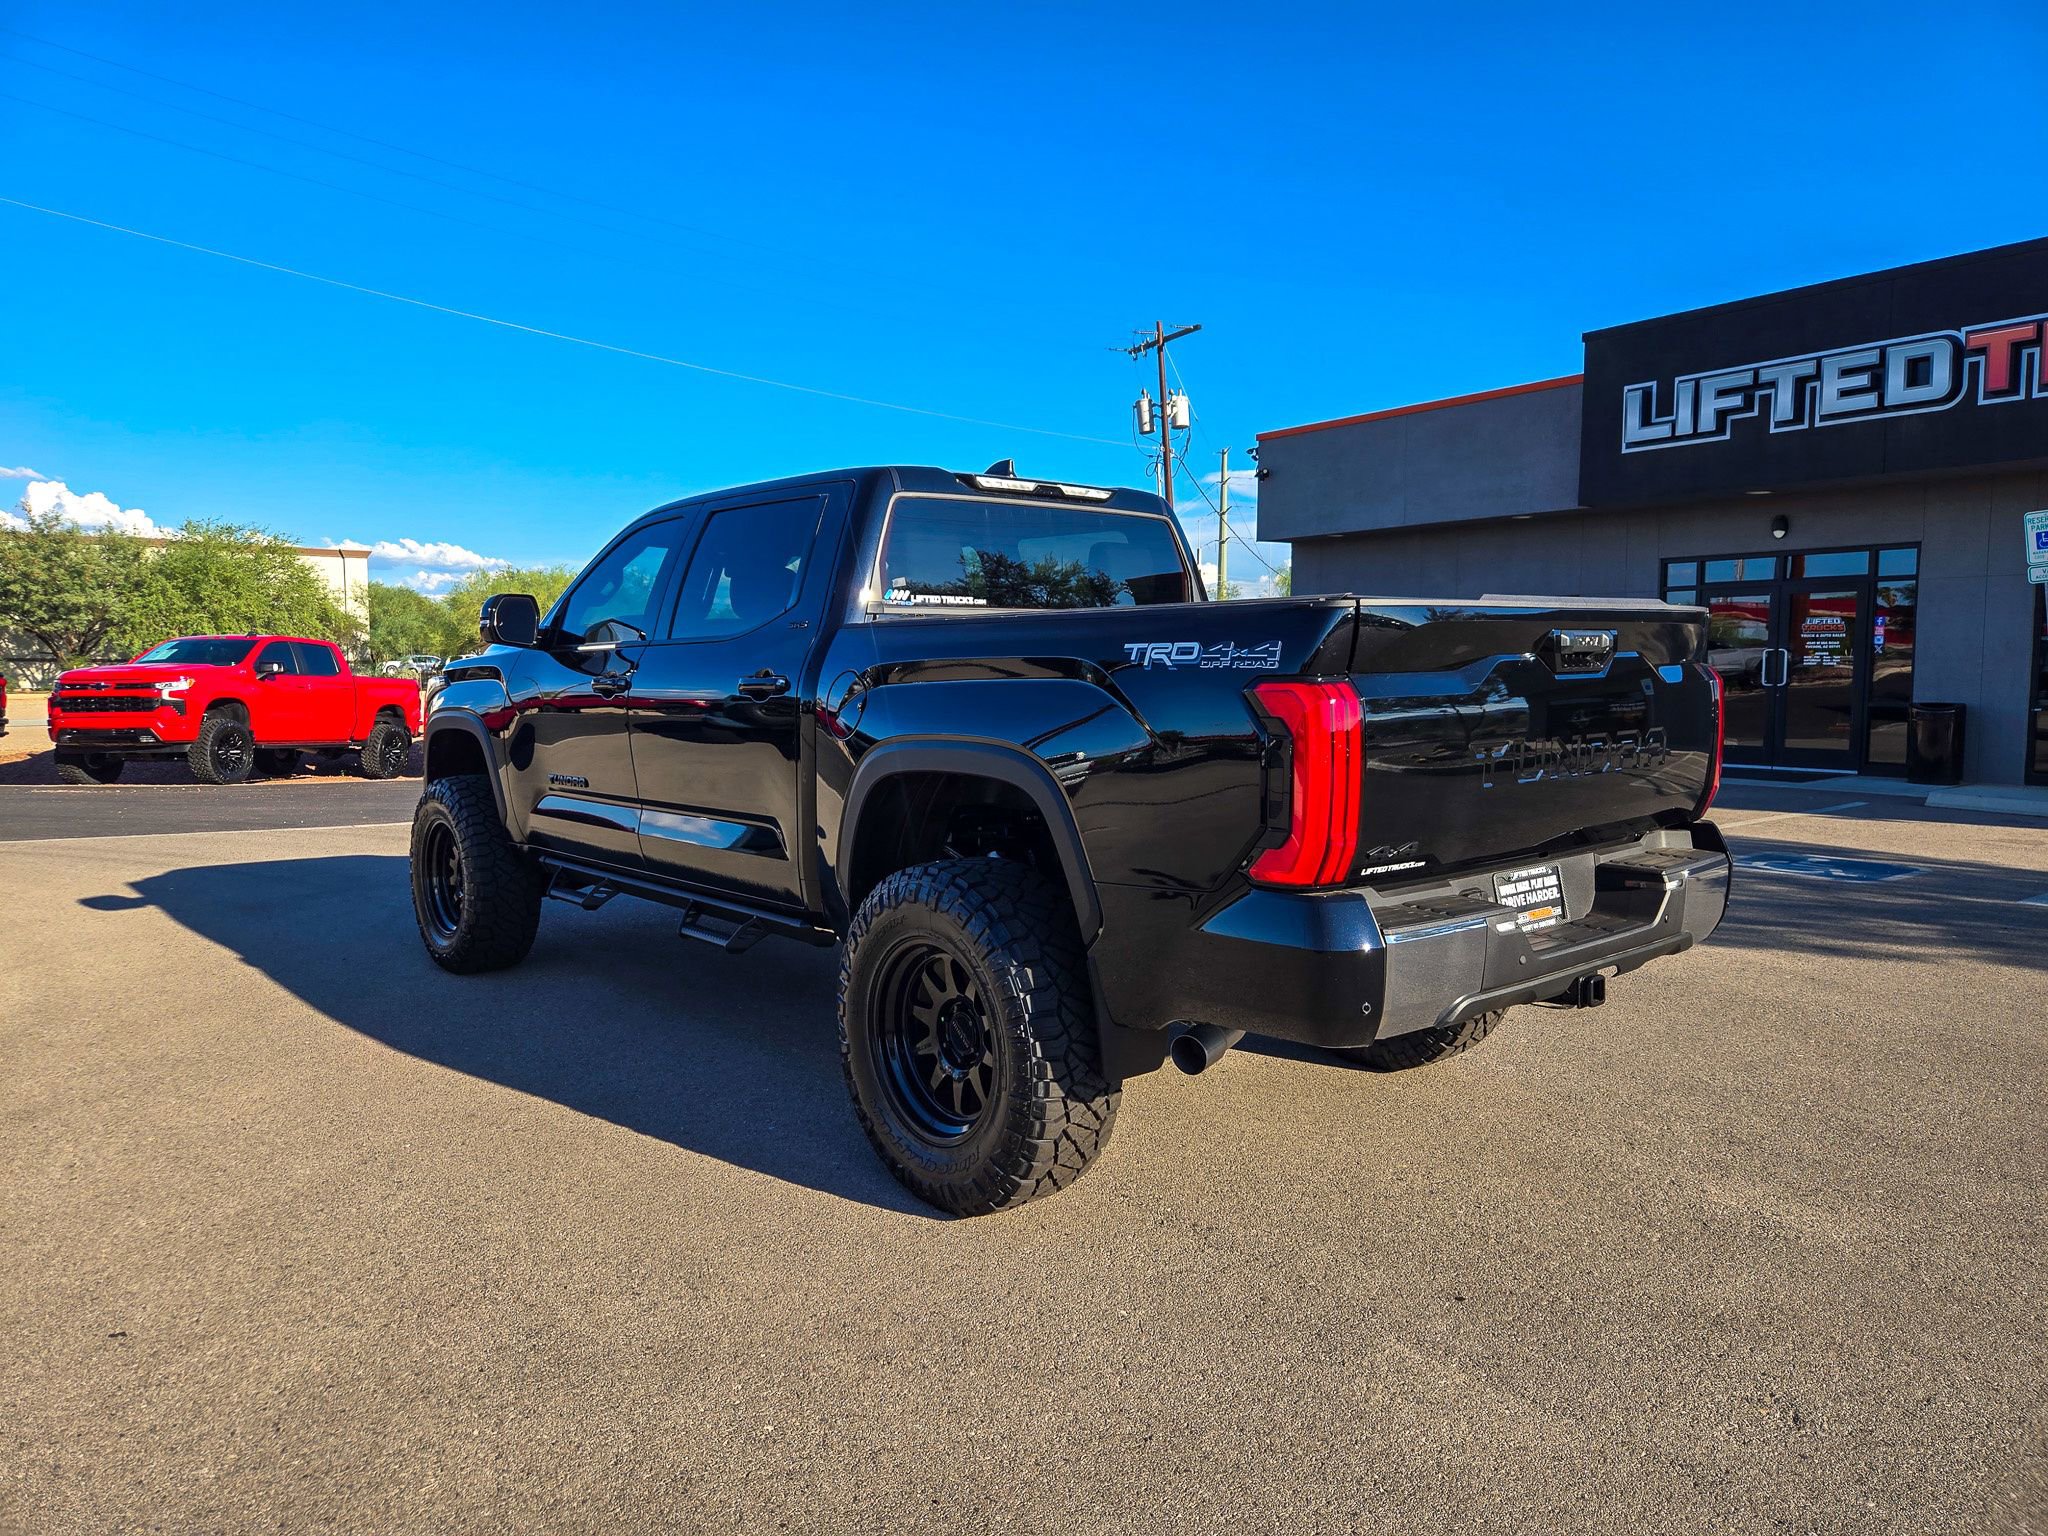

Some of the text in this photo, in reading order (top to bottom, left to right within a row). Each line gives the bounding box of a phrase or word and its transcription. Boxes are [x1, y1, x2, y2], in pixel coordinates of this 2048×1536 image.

[1623, 336, 1962, 446] LIFTED
[1806, 617, 1841, 625] LIFTED
[1124, 642, 1202, 670] TRD
[1200, 660, 1280, 669] OFF ROAD
[1469, 727, 1667, 788] TUNDRA
[547, 773, 589, 788] TUNDRA
[1501, 891, 1527, 908] DRIVE
